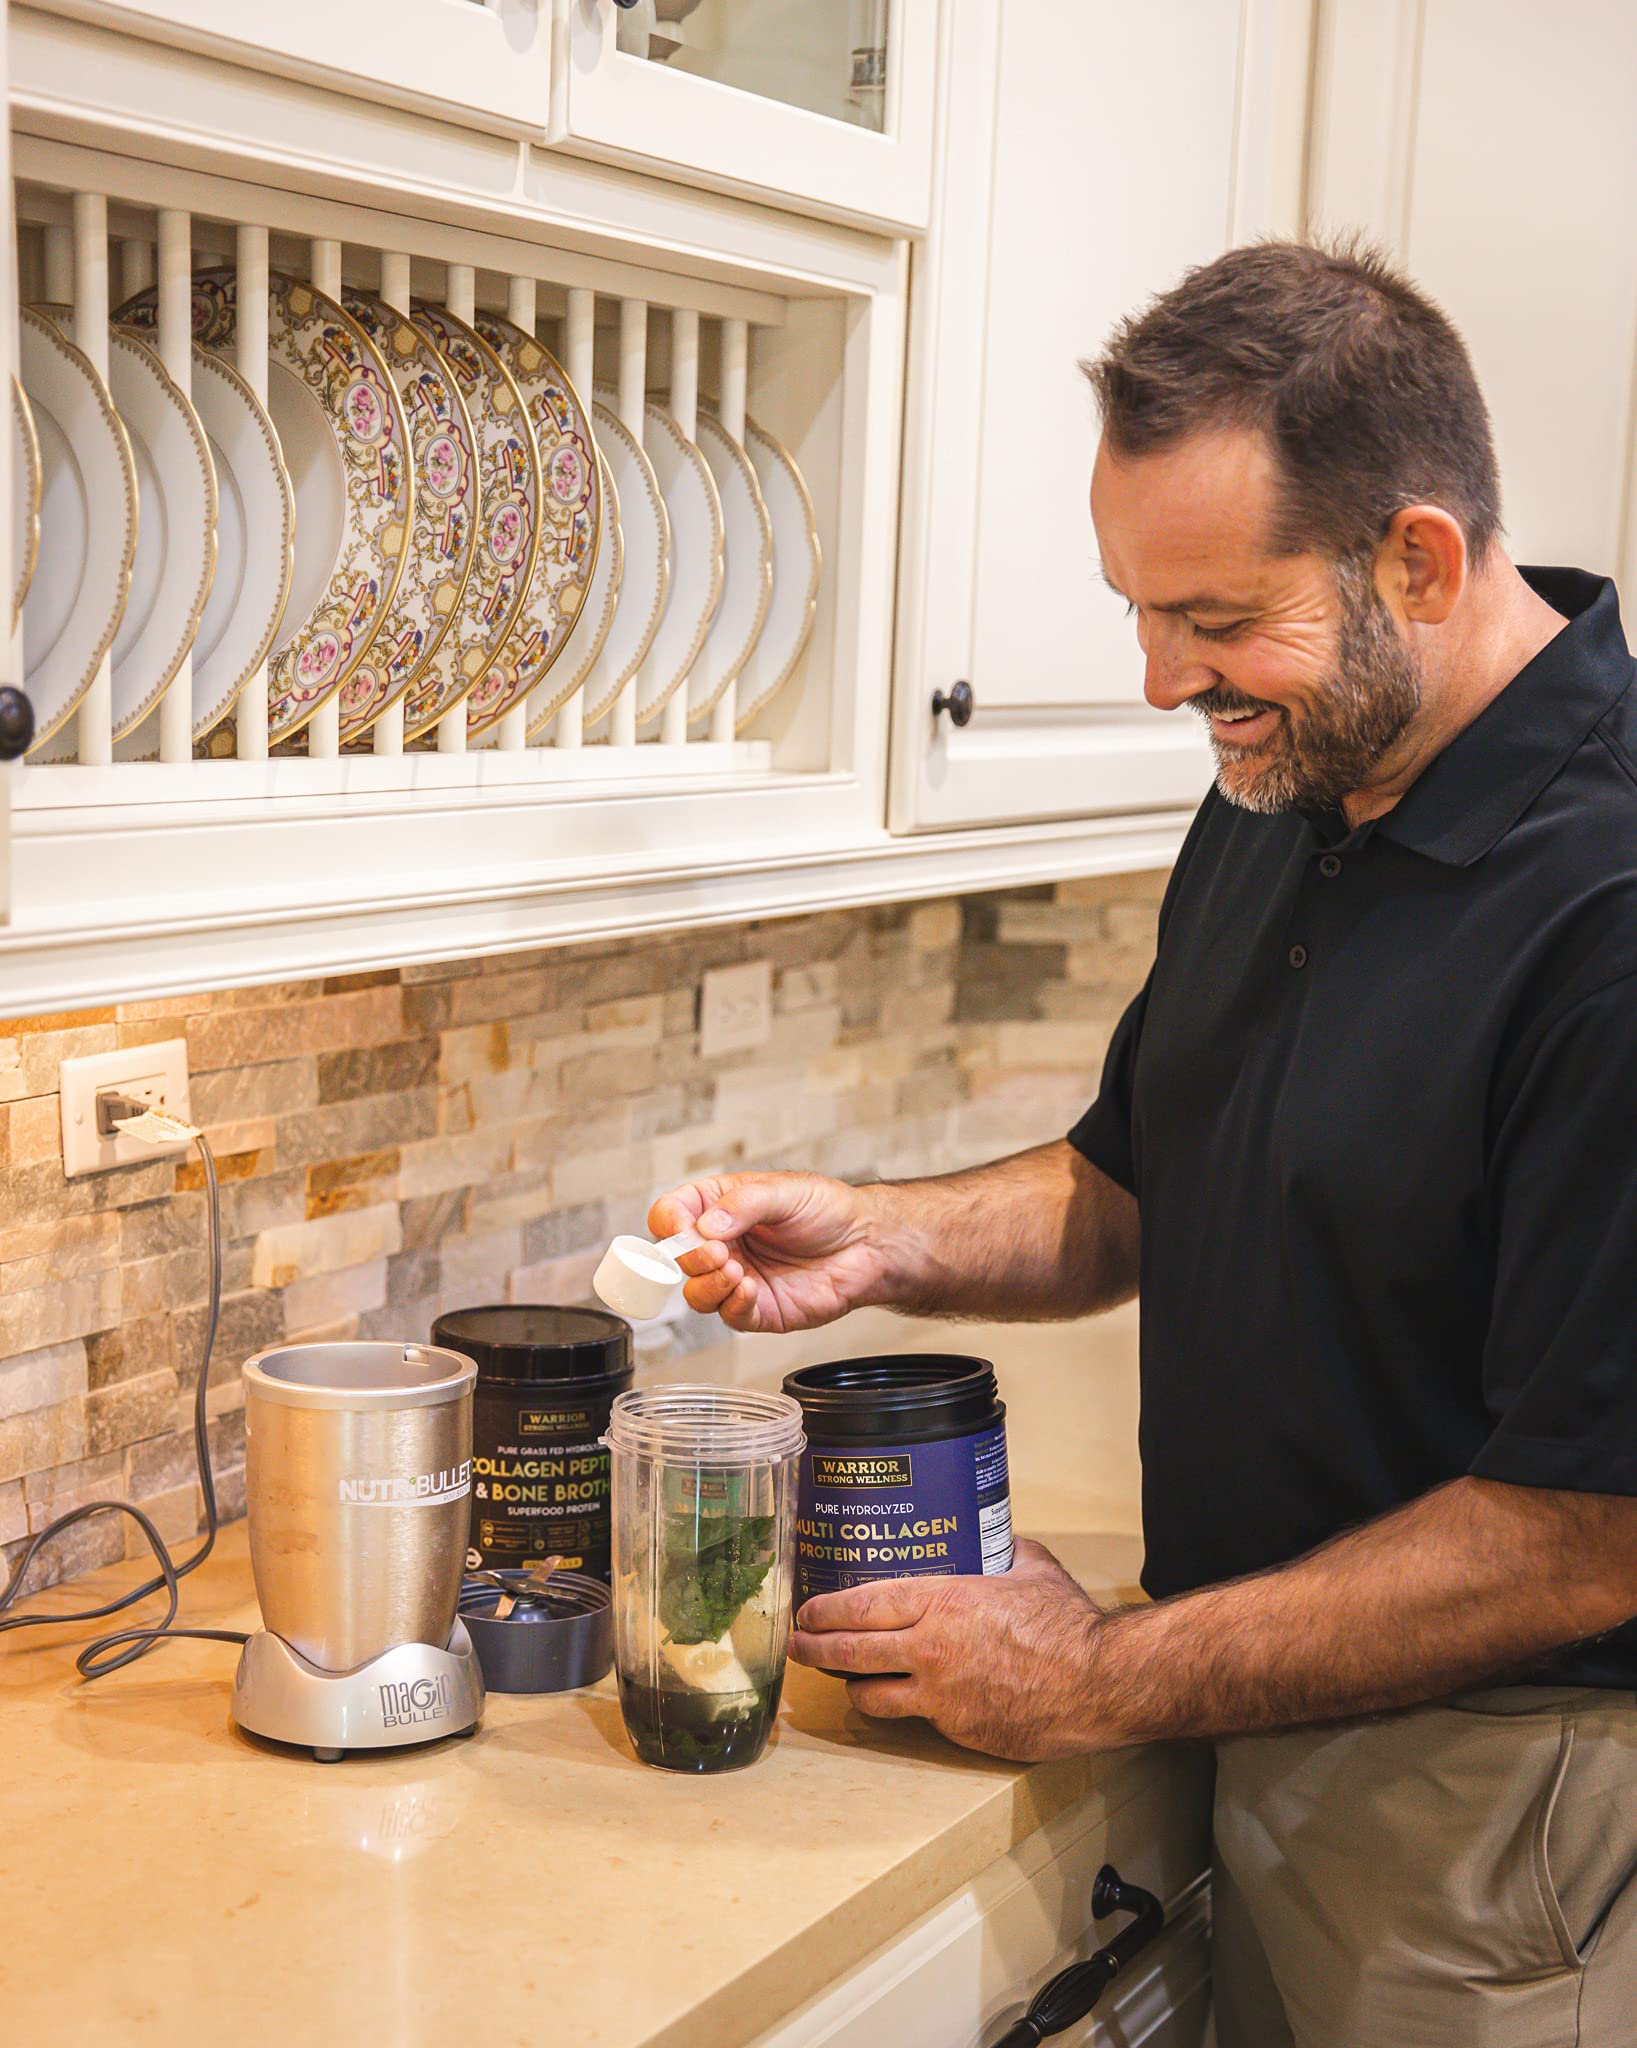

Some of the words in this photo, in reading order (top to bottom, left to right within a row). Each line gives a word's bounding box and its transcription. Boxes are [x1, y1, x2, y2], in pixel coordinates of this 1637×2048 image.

[529, 1412, 587, 1425] WARRIOR
[497, 1446, 519, 1456] PURE
[520, 1447, 548, 1456] GRASS
[550, 1447, 565, 1456] FED
[822, 1460, 900, 1474] WARRIOR
[817, 1474, 854, 1484] STRONG
[856, 1473, 908, 1484] WELLNESS
[475, 1482, 488, 1499] &
[491, 1483, 548, 1502] BONE
[507, 1506, 563, 1516] SUPERFOOD
[565, 1502, 600, 1514] PROTEIN
[815, 1502, 840, 1515] PURE
[842, 1502, 914, 1515] HYDROLYZED
[839, 1515, 958, 1541] COLLAGEN
[800, 1541, 861, 1563] PROTEIN
[866, 1541, 949, 1563] POWDER
[383, 1705, 450, 1729] BULLET
